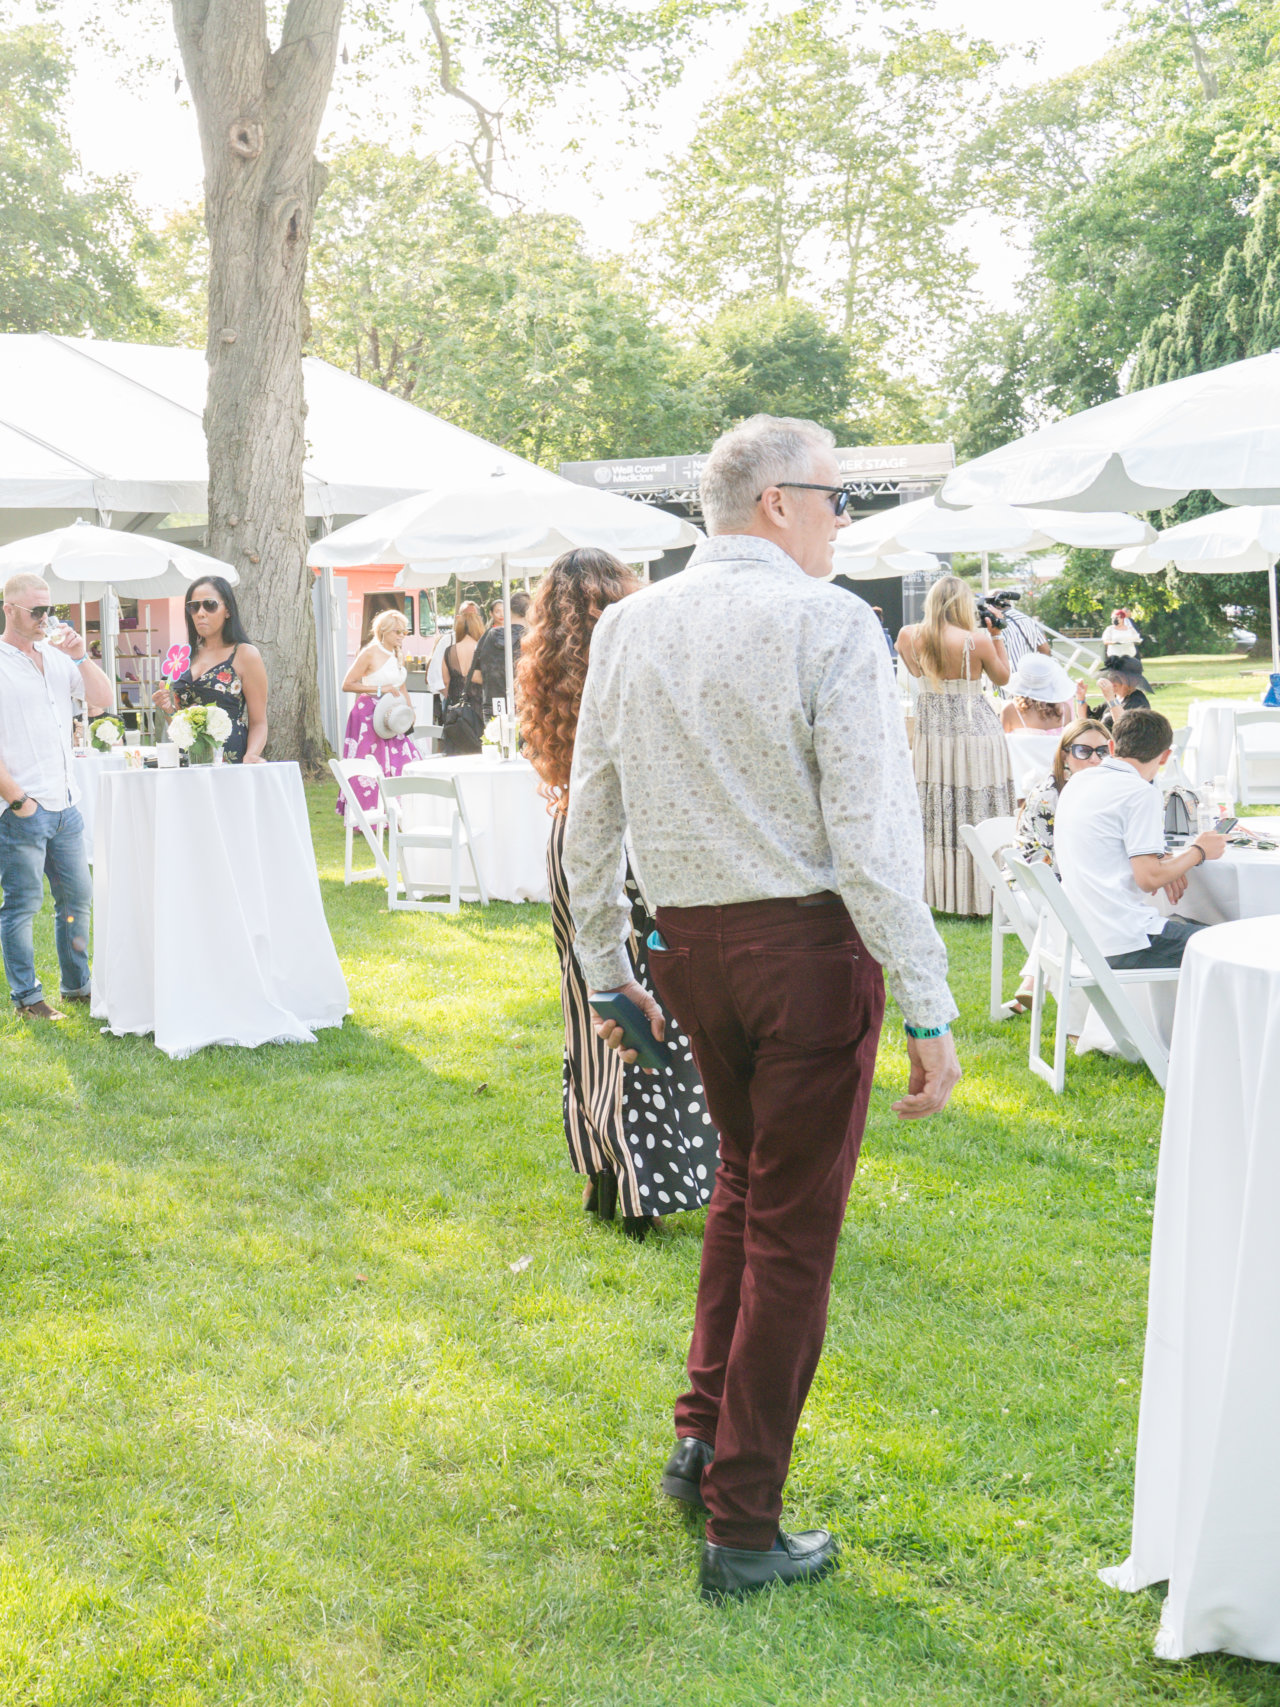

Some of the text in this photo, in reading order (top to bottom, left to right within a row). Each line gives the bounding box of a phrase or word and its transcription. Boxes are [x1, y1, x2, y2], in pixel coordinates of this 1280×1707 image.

[865, 458, 908, 469] STAGE
[612, 473, 654, 482] Medicine
[496, 700, 502, 713] 6
